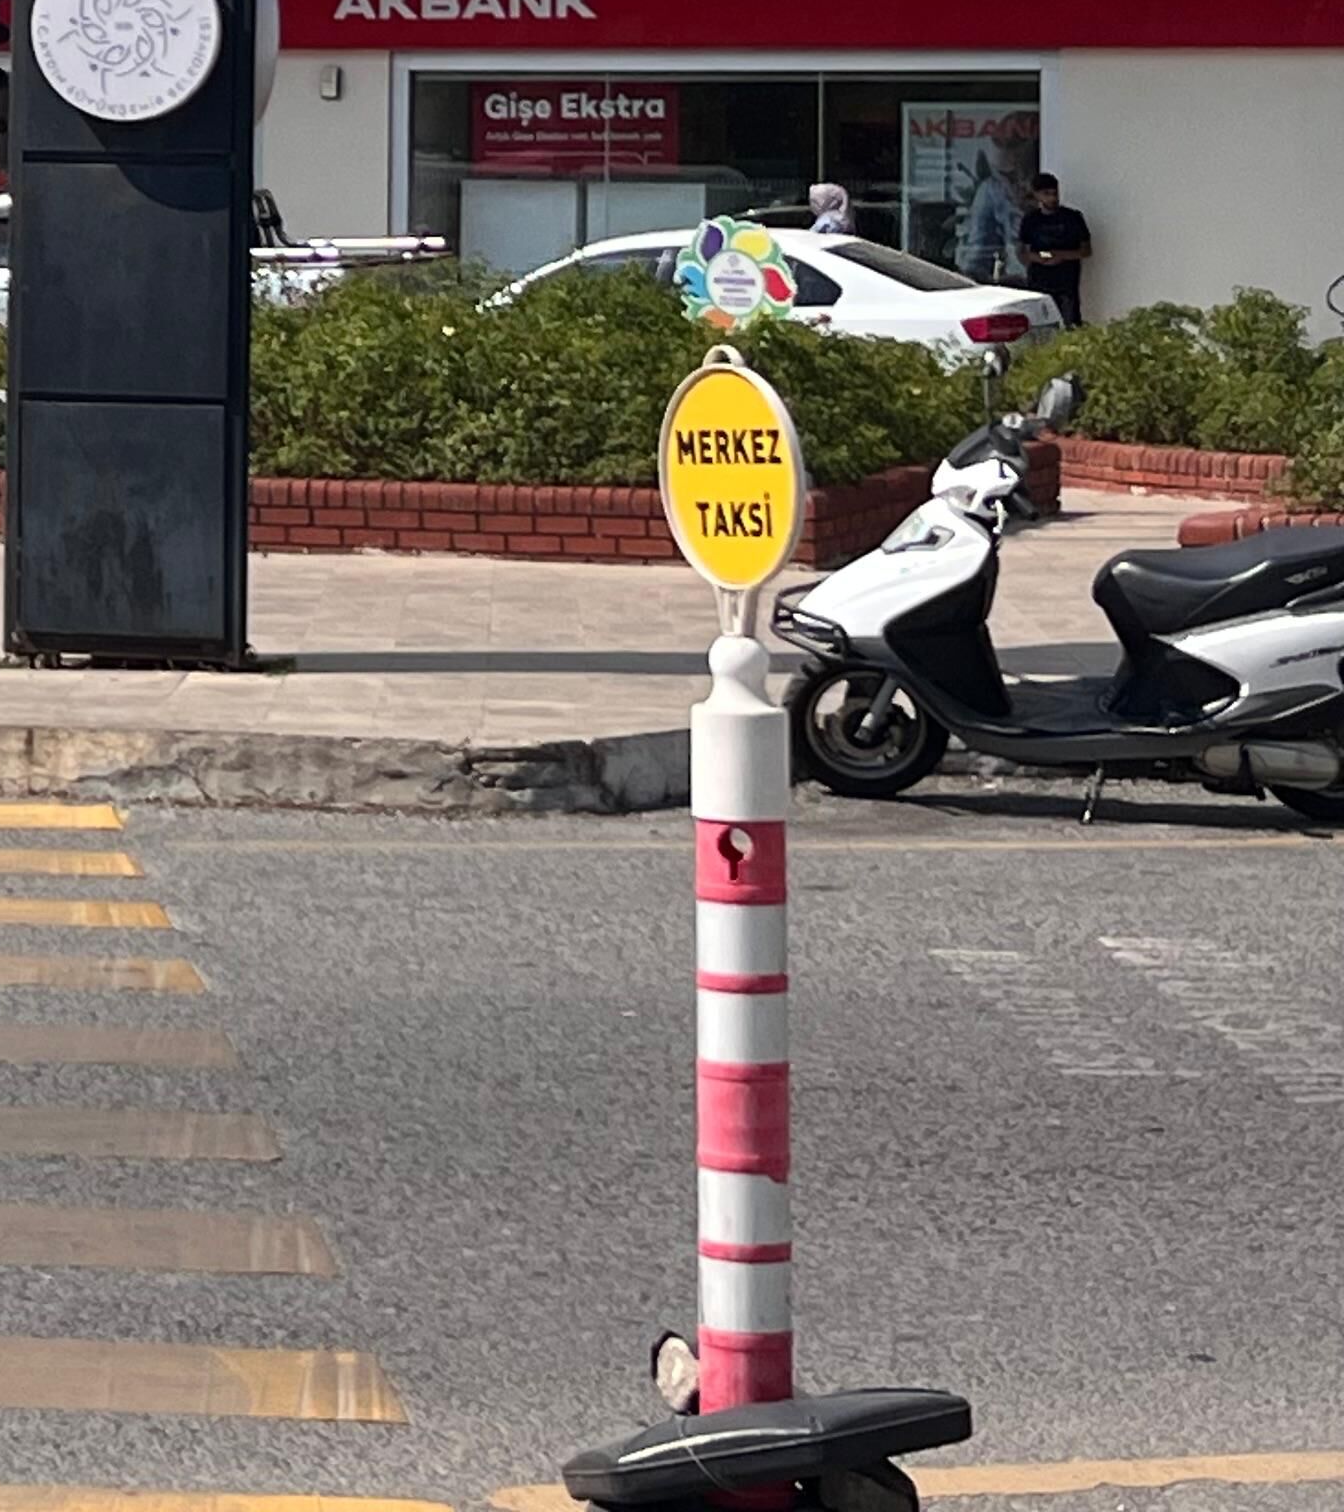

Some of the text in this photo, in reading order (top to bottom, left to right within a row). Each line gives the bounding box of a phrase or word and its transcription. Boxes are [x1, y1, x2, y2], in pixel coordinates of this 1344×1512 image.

[484, 91, 666, 127] Gişe Ekstra
[675, 428, 783, 465] MERKEZ
[695, 491, 774, 538] TAKSİ
